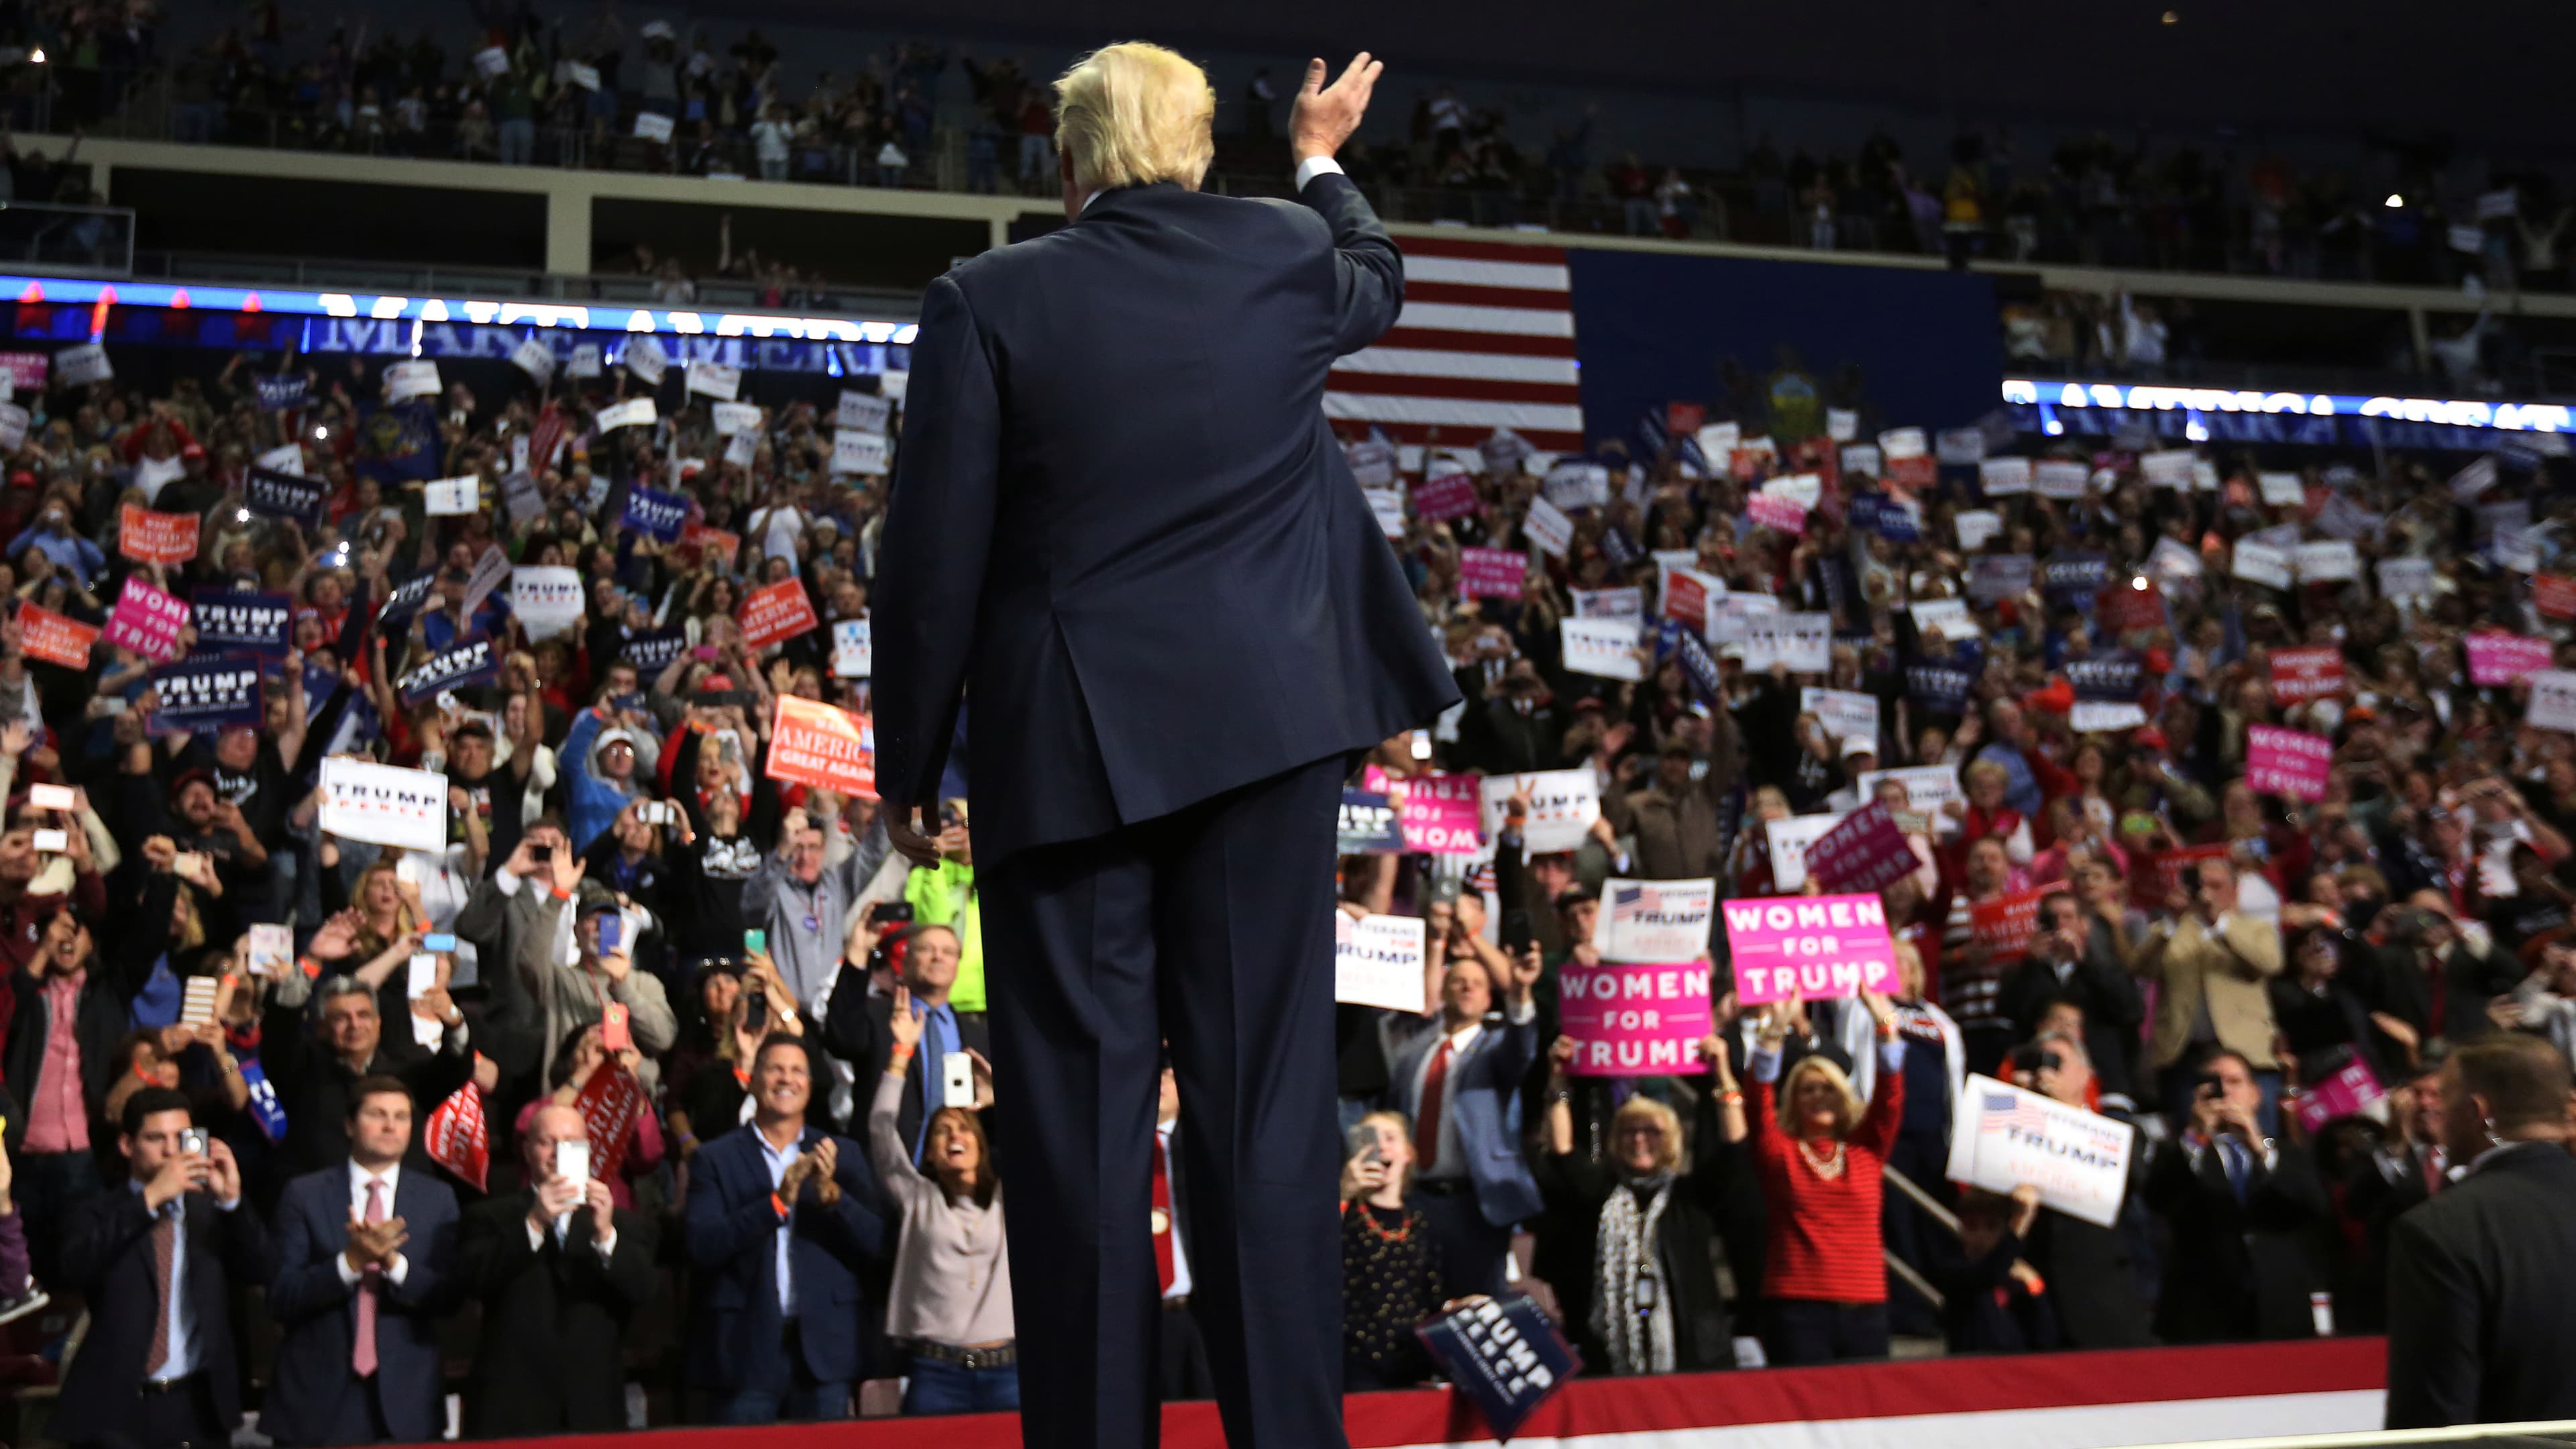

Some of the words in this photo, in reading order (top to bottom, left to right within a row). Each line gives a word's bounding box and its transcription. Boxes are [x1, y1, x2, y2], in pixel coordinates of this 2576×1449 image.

[195, 604, 288, 624] TRUMP
[154, 670, 257, 694] TRUMP
[2249, 728, 2332, 759] WOMEN
[780, 748, 826, 772] GREAT
[2276, 754, 2308, 771] FOR
[2250, 767, 2324, 793] TRUMP
[333, 782, 436, 805] TRUMP
[1494, 795, 1588, 813] TUMP
[339, 800, 423, 818] PENCE
[1634, 910, 1706, 925] TRUMP
[1726, 901, 1886, 933] WOMEN
[1336, 943, 1417, 965] RUMP
[1782, 936, 1840, 957] FOR
[1560, 970, 1709, 1000] WOMEN
[1743, 961, 1889, 998] TRUMP
[1603, 1011, 1660, 1030] FOR
[2007, 1124, 2119, 1169] TRUMP
[1476, 1301, 1555, 1390] RUMP
